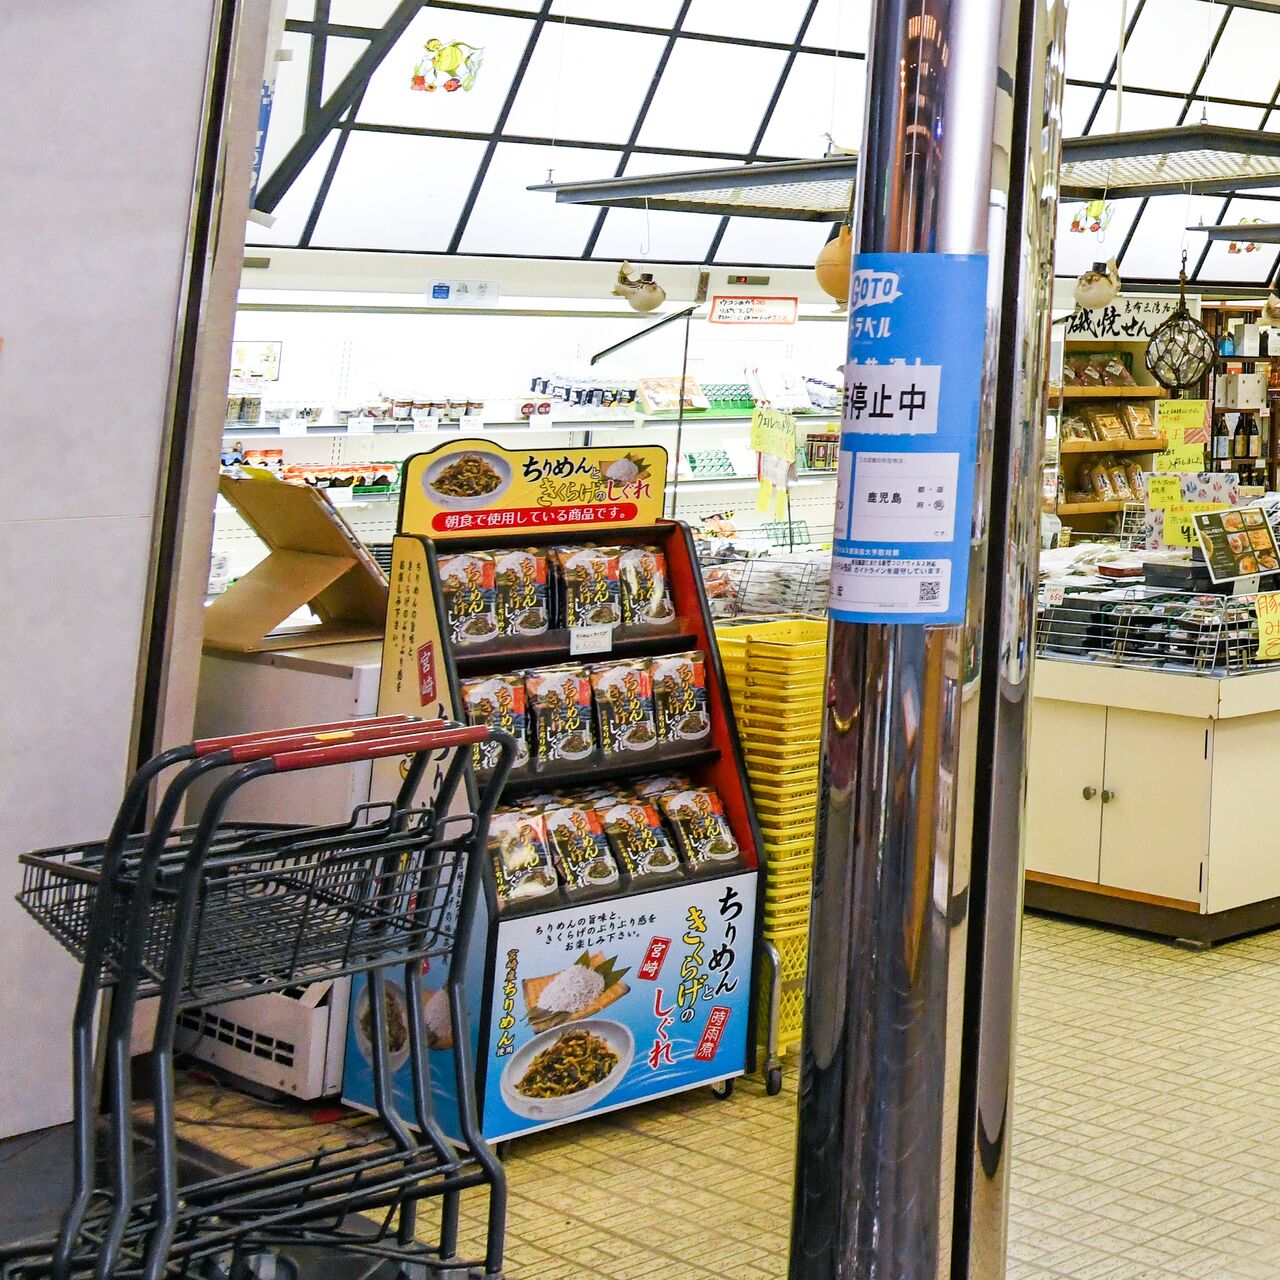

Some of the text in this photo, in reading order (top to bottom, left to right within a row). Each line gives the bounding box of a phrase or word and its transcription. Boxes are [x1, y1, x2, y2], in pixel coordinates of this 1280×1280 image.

[1065, 306, 1153, 338] 磯焼せん
[522, 455, 601, 483] ちりめんと
[606, 479, 653, 502] しぐれ
[867, 491, 902, 505] 鹿児島
[444, 506, 627, 529] 朝食で使用している商品です。
[1049, 593, 1064, 602] 650
[420, 651, 435, 697] 宮崎
[642, 941, 667, 977] 宮崎
[701, 885, 744, 1001] ちりめんと
[676, 905, 710, 1023] きくらげの
[647, 988, 677, 1070] しぐれ
[698, 1010, 727, 1058] 時雨煮
